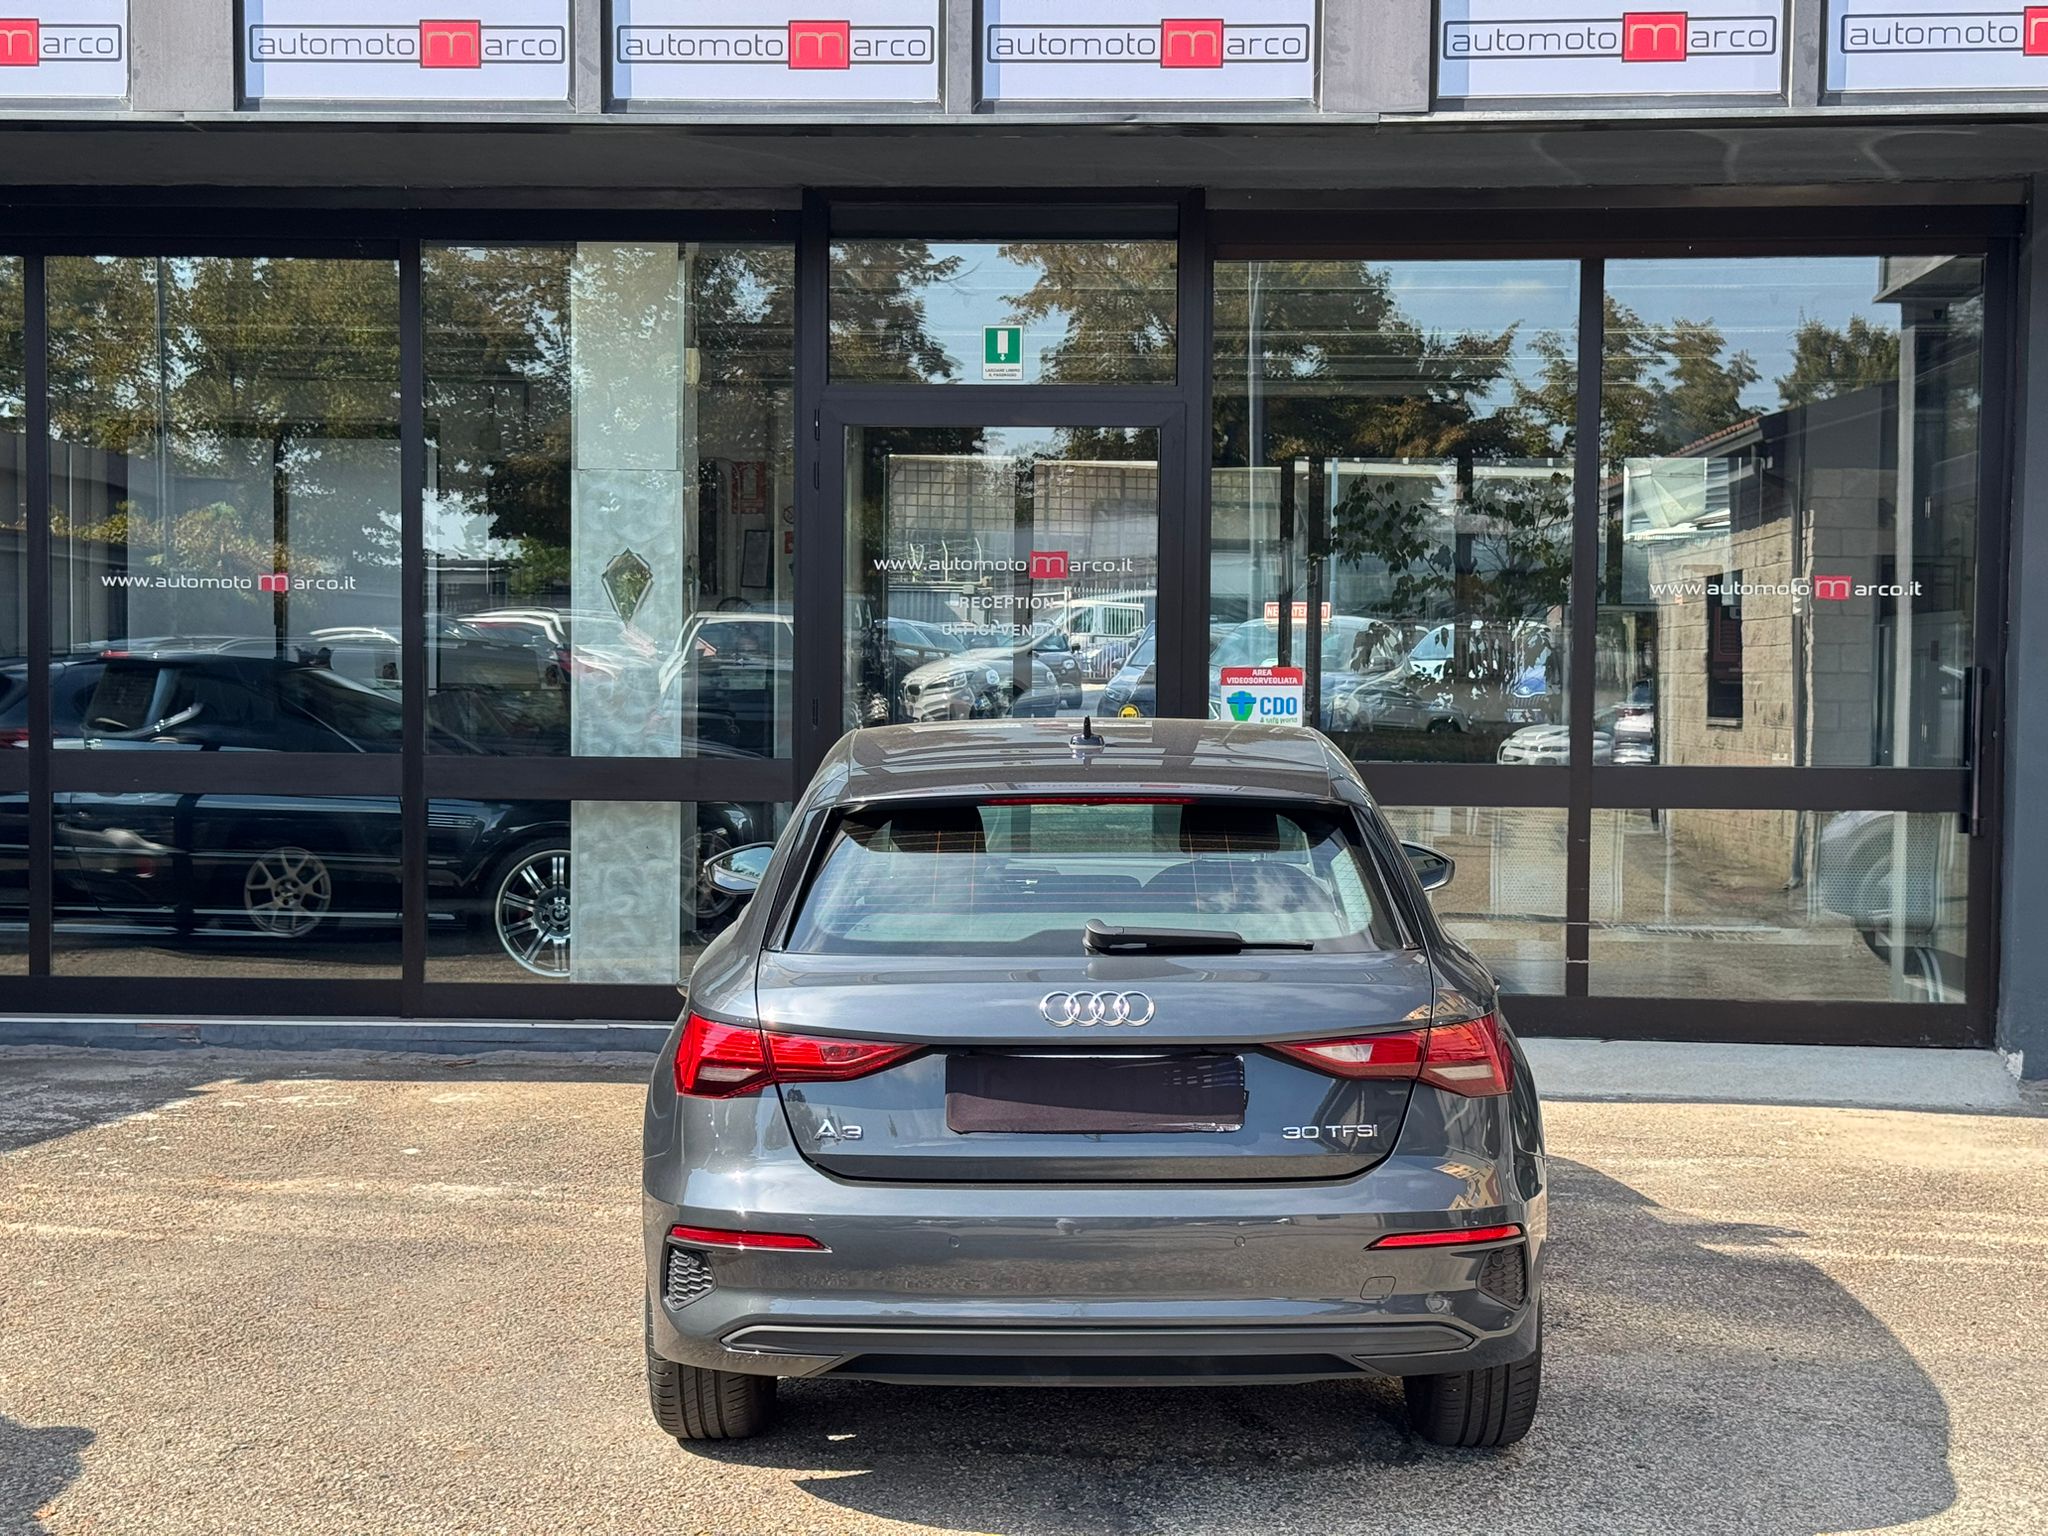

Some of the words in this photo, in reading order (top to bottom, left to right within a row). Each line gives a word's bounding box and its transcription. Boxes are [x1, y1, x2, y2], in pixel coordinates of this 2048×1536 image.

[959, 596, 1054, 609] RECEPTION
[1260, 696, 1298, 715] CDO
[814, 1118, 863, 1141] A3
[1282, 1125, 1319, 1139] 30
[1325, 1123, 1378, 1138] TFSI
